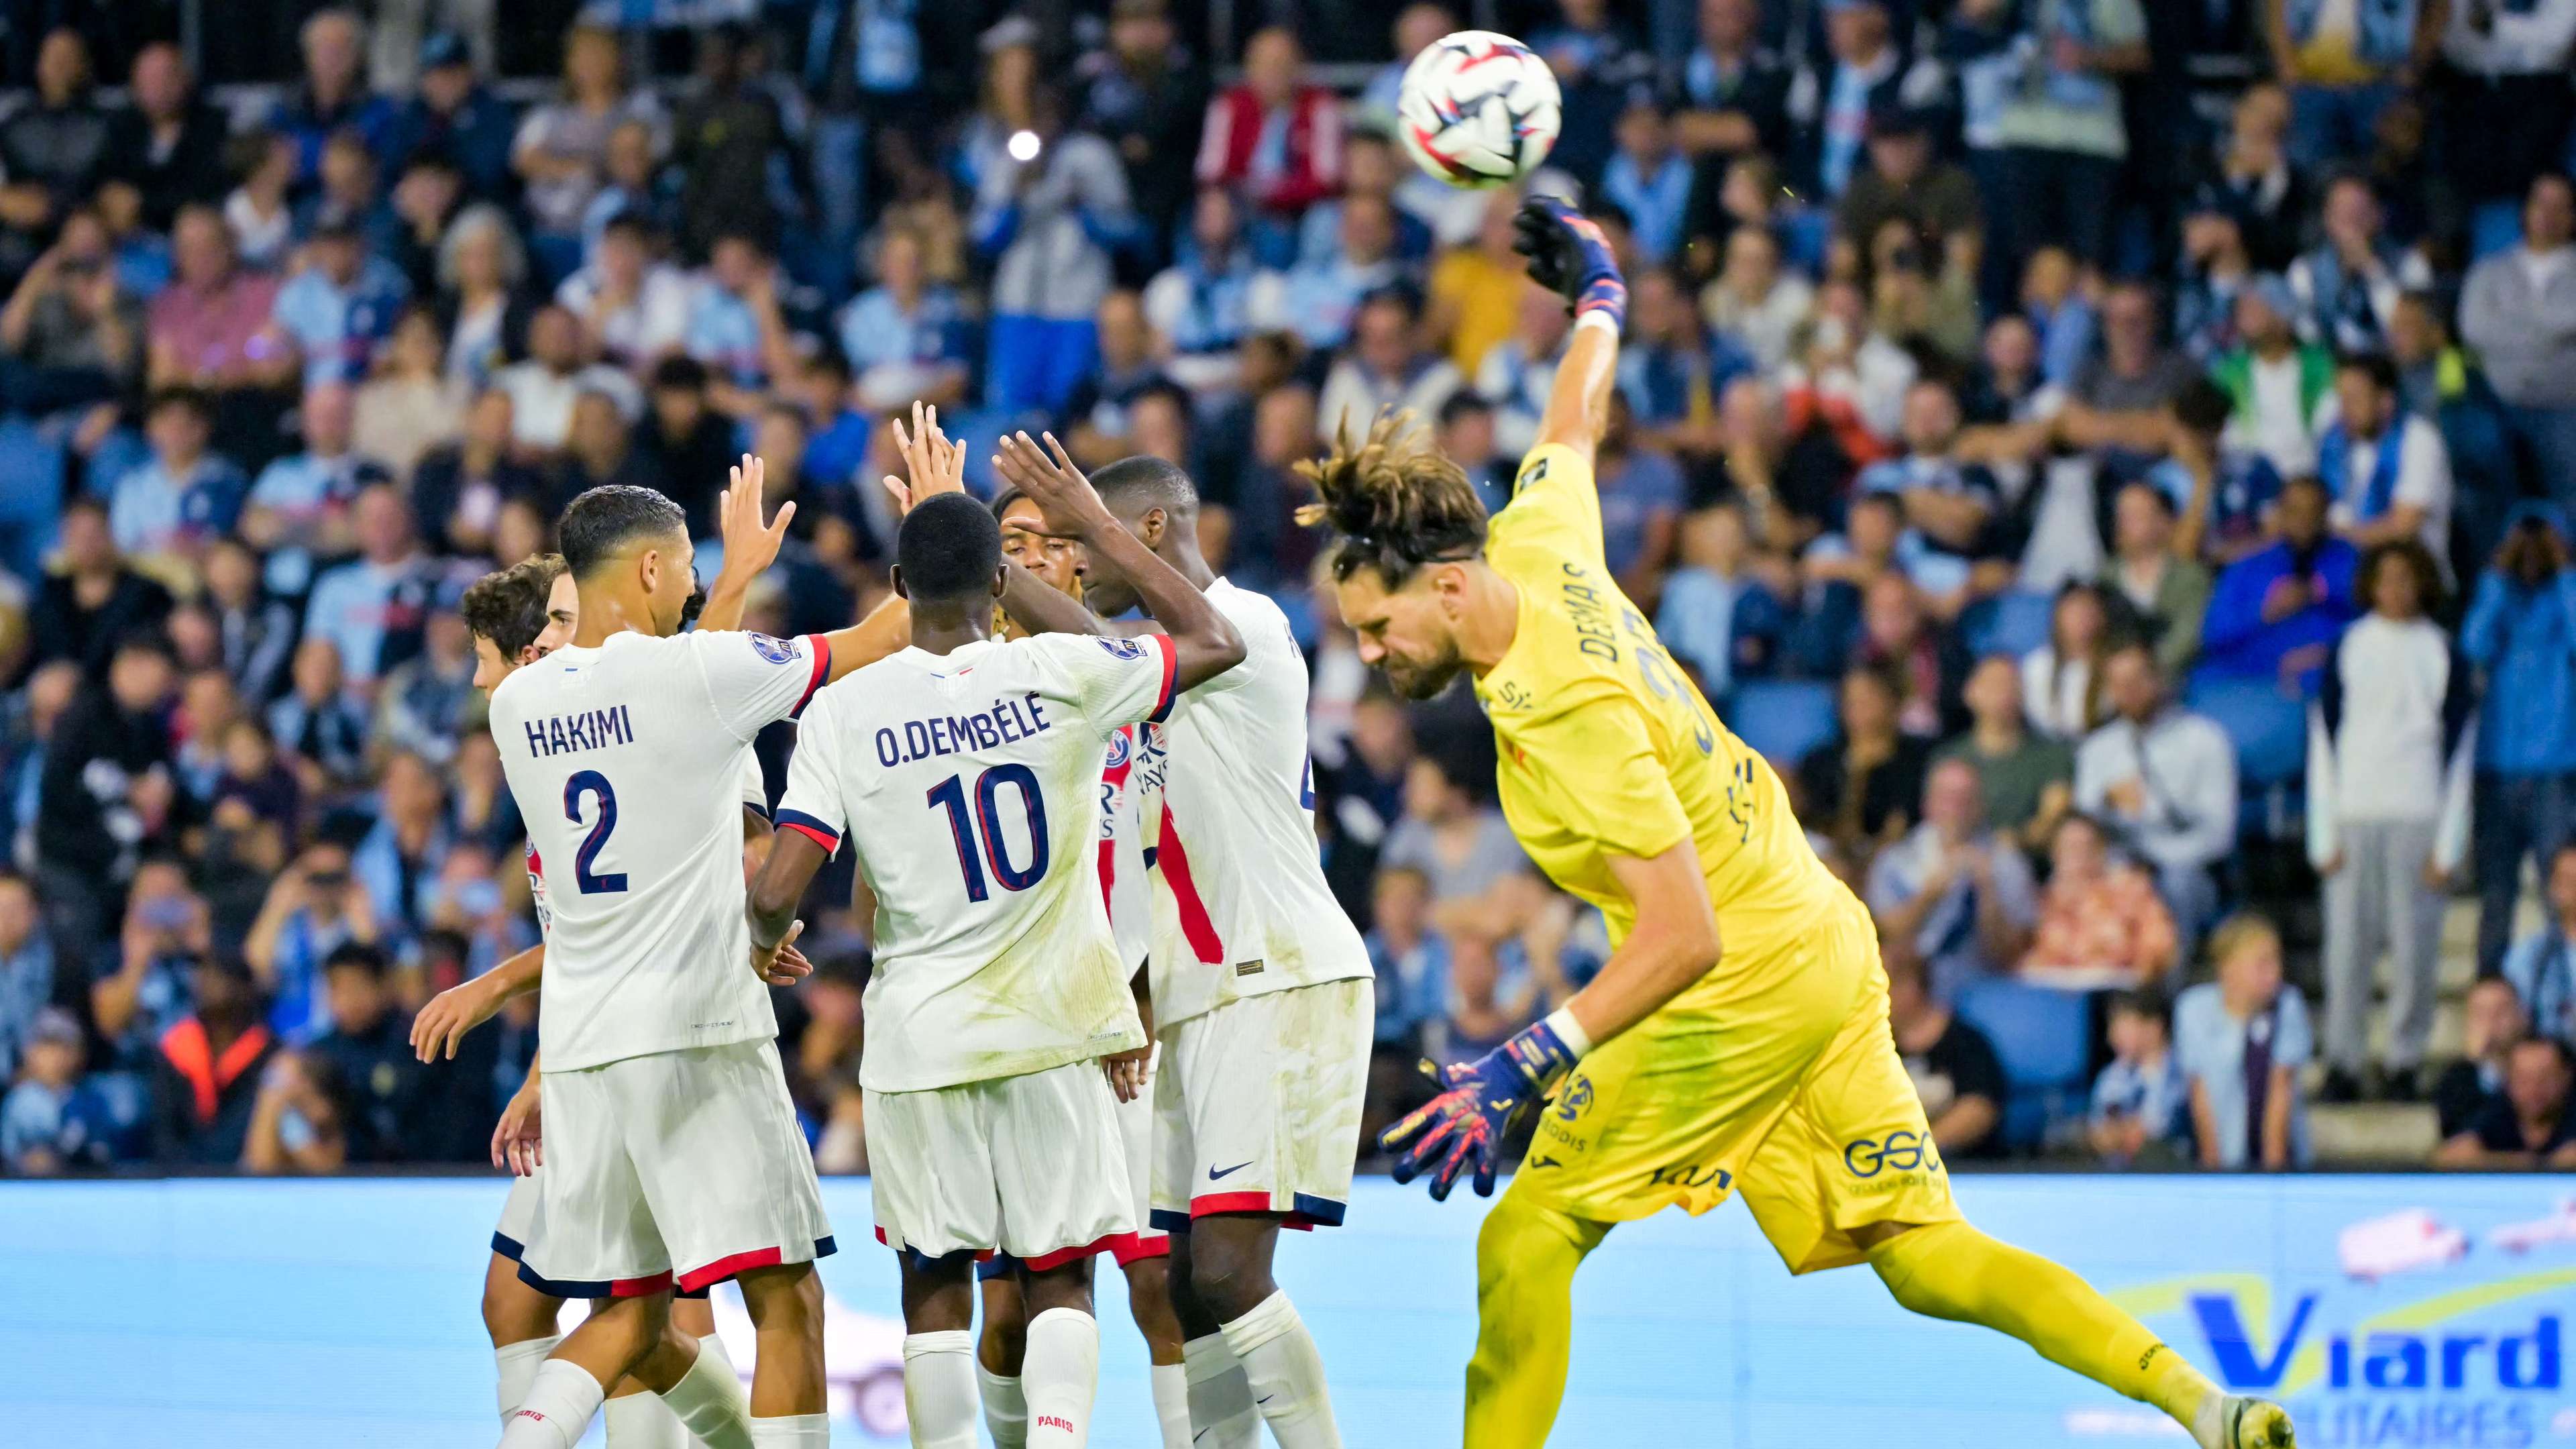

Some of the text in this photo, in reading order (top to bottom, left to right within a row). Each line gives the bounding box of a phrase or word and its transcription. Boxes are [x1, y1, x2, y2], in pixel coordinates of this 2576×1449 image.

[524, 704, 634, 758] HAKIMI
[875, 692, 1051, 767] O.DEMBÉLÉ
[564, 769, 628, 895] 2
[926, 763, 1051, 904] 10
[2190, 1295, 2561, 1389] Viard
[1038, 1415, 1073, 1433] PARIS
